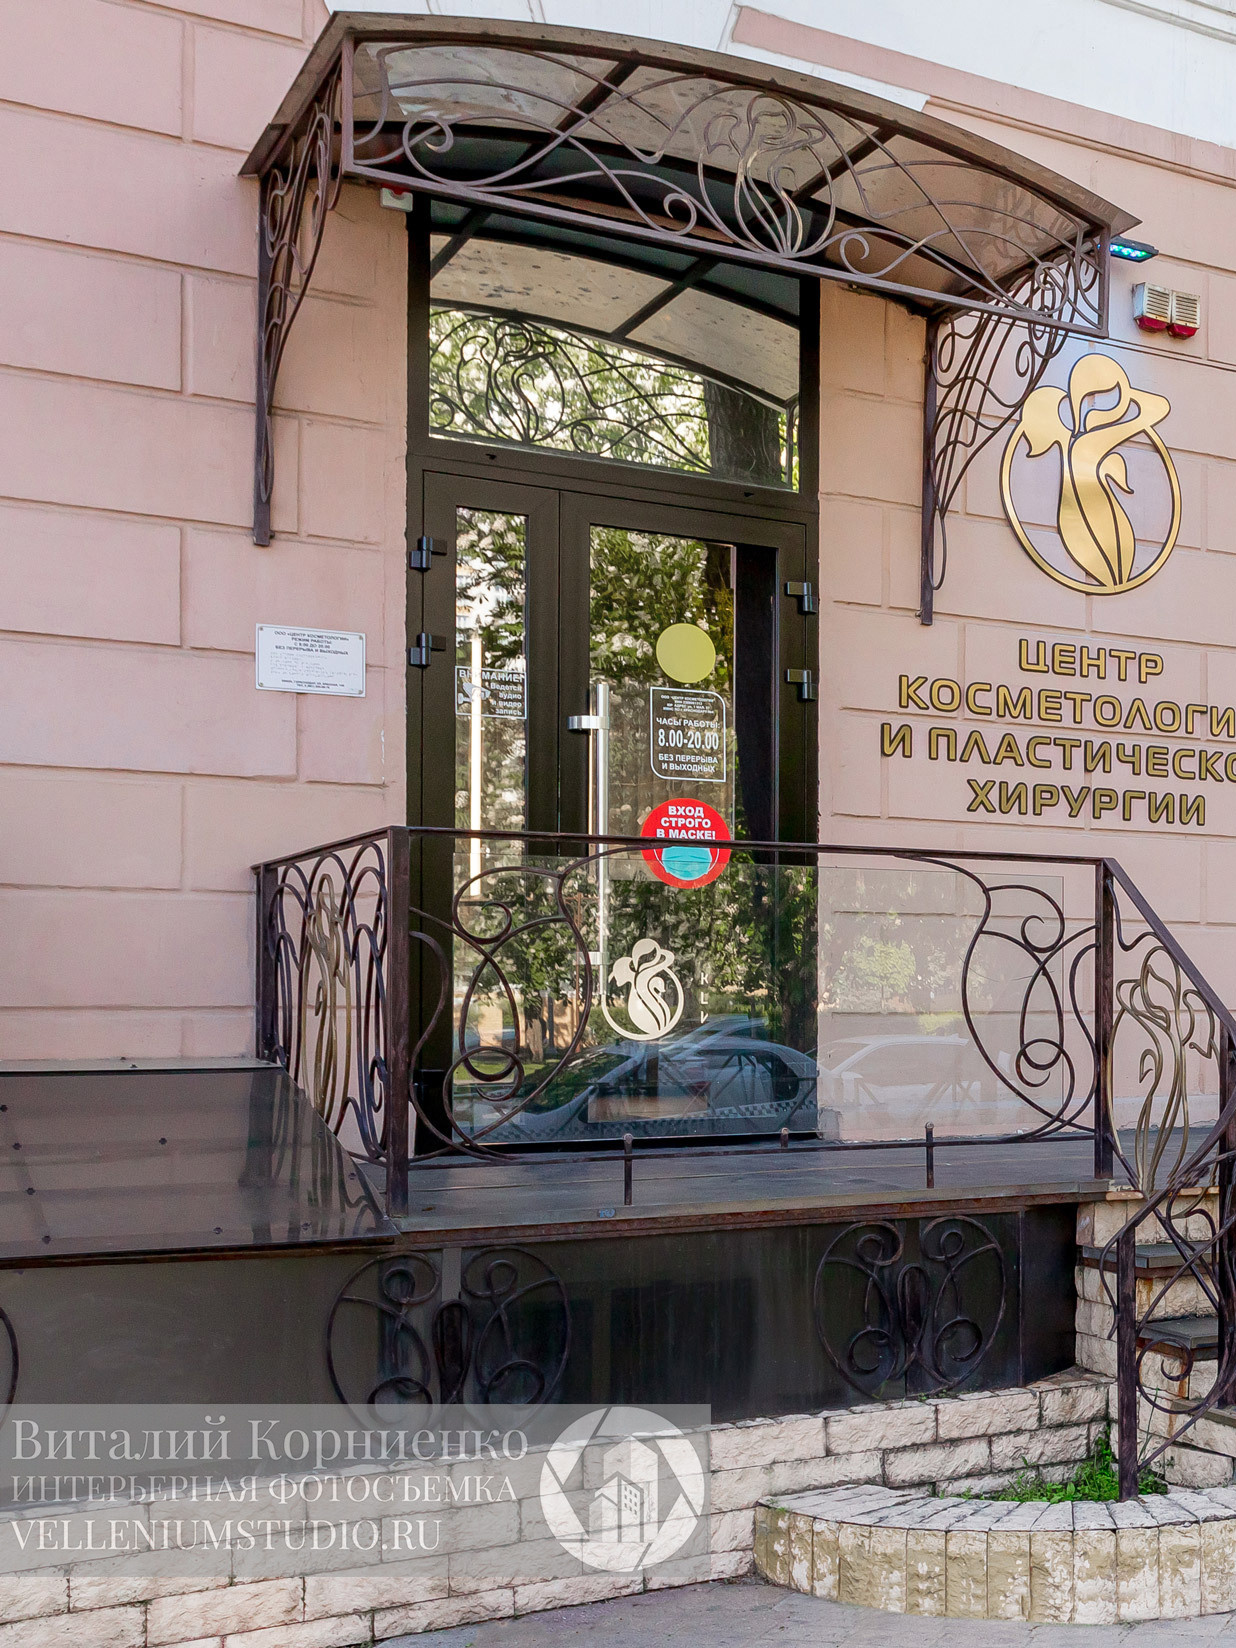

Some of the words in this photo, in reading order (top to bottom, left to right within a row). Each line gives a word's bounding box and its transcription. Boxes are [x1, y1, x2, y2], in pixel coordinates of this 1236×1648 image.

[1018, 638, 1164, 684] ЦЕНТР
[459, 669, 523, 682] ВНМАНИЕ!
[656, 717, 682, 726] ЧАСЫ
[658, 728, 719, 750] 8.00-20.00
[881, 722, 913, 758] И
[658, 753, 674, 761] БЕЗ
[675, 754, 719, 764] ПЕРЕРЫВА
[669, 763, 716, 772] ВЫХОДНЫХ
[966, 778, 1206, 827] ХИРУРГИИ
[668, 805, 705, 818] ВХОД
[660, 817, 711, 828] СТРОГО
[656, 828, 666, 838] В
[668, 829, 716, 840] МАСКЕ!
